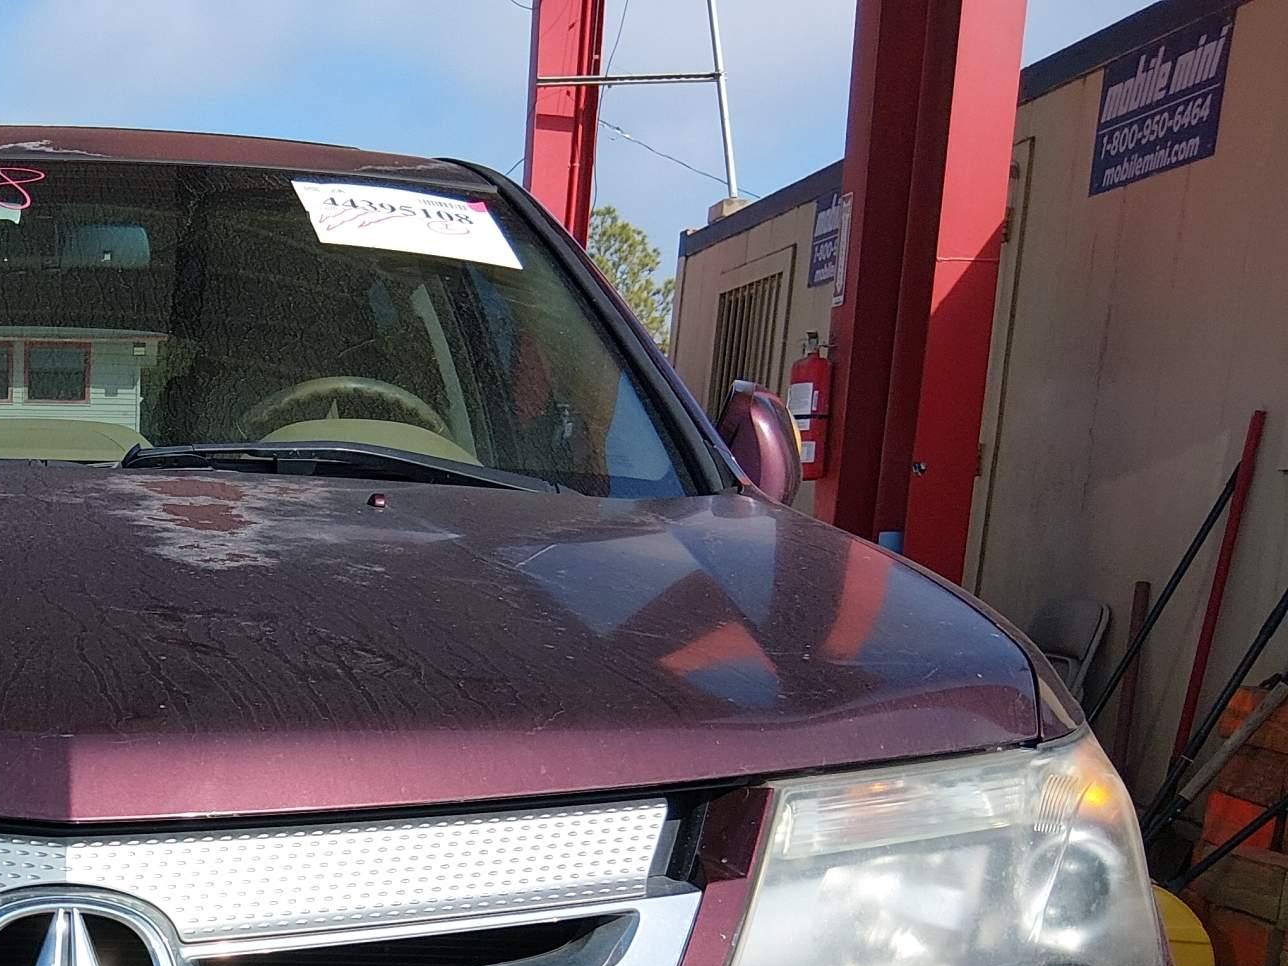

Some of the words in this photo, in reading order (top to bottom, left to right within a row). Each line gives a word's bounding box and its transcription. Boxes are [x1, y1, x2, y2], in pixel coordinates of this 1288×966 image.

[1101, 45, 1172, 124] mobile
[1171, 27, 1230, 94] mini
[1100, 93, 1213, 161] 1-800-950-6464
[1102, 136, 1201, 187] mobilemini.com
[322, 196, 475, 225] 44395108
